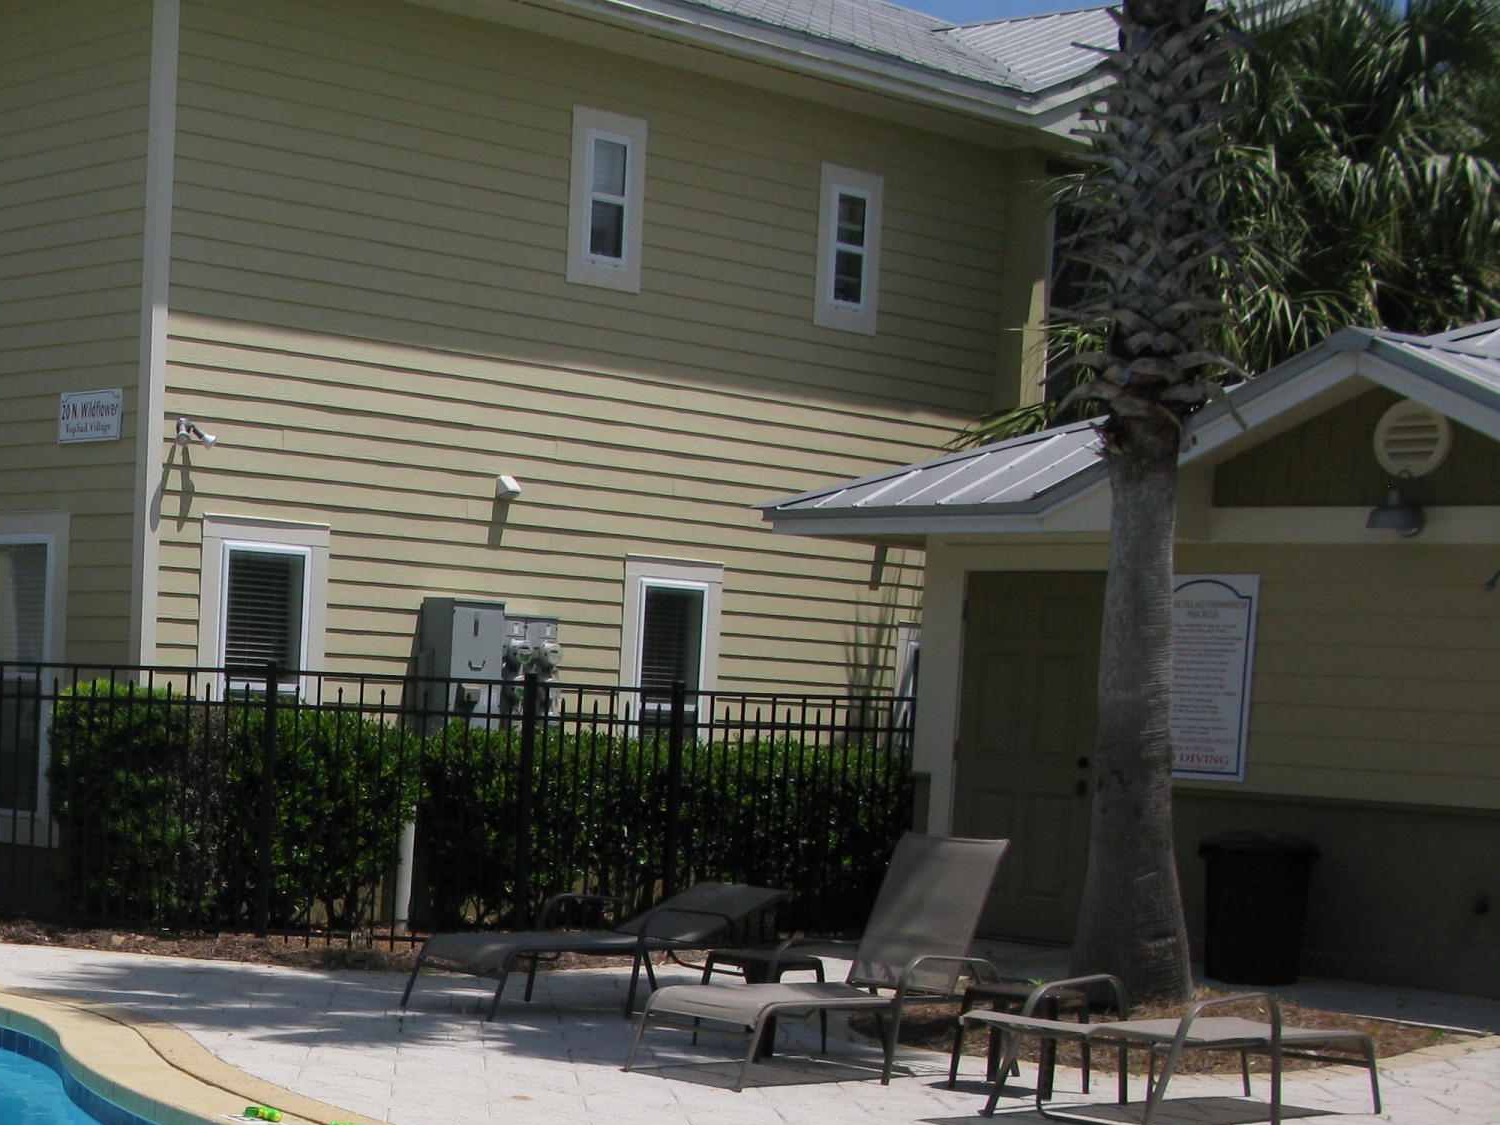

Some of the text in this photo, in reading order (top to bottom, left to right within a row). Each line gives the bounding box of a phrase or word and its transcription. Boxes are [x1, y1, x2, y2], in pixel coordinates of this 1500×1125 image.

[61, 400, 119, 420] 20 N. Wildflower
[89, 421, 111, 434] Village
[1180, 753, 1230, 766] DIVING
